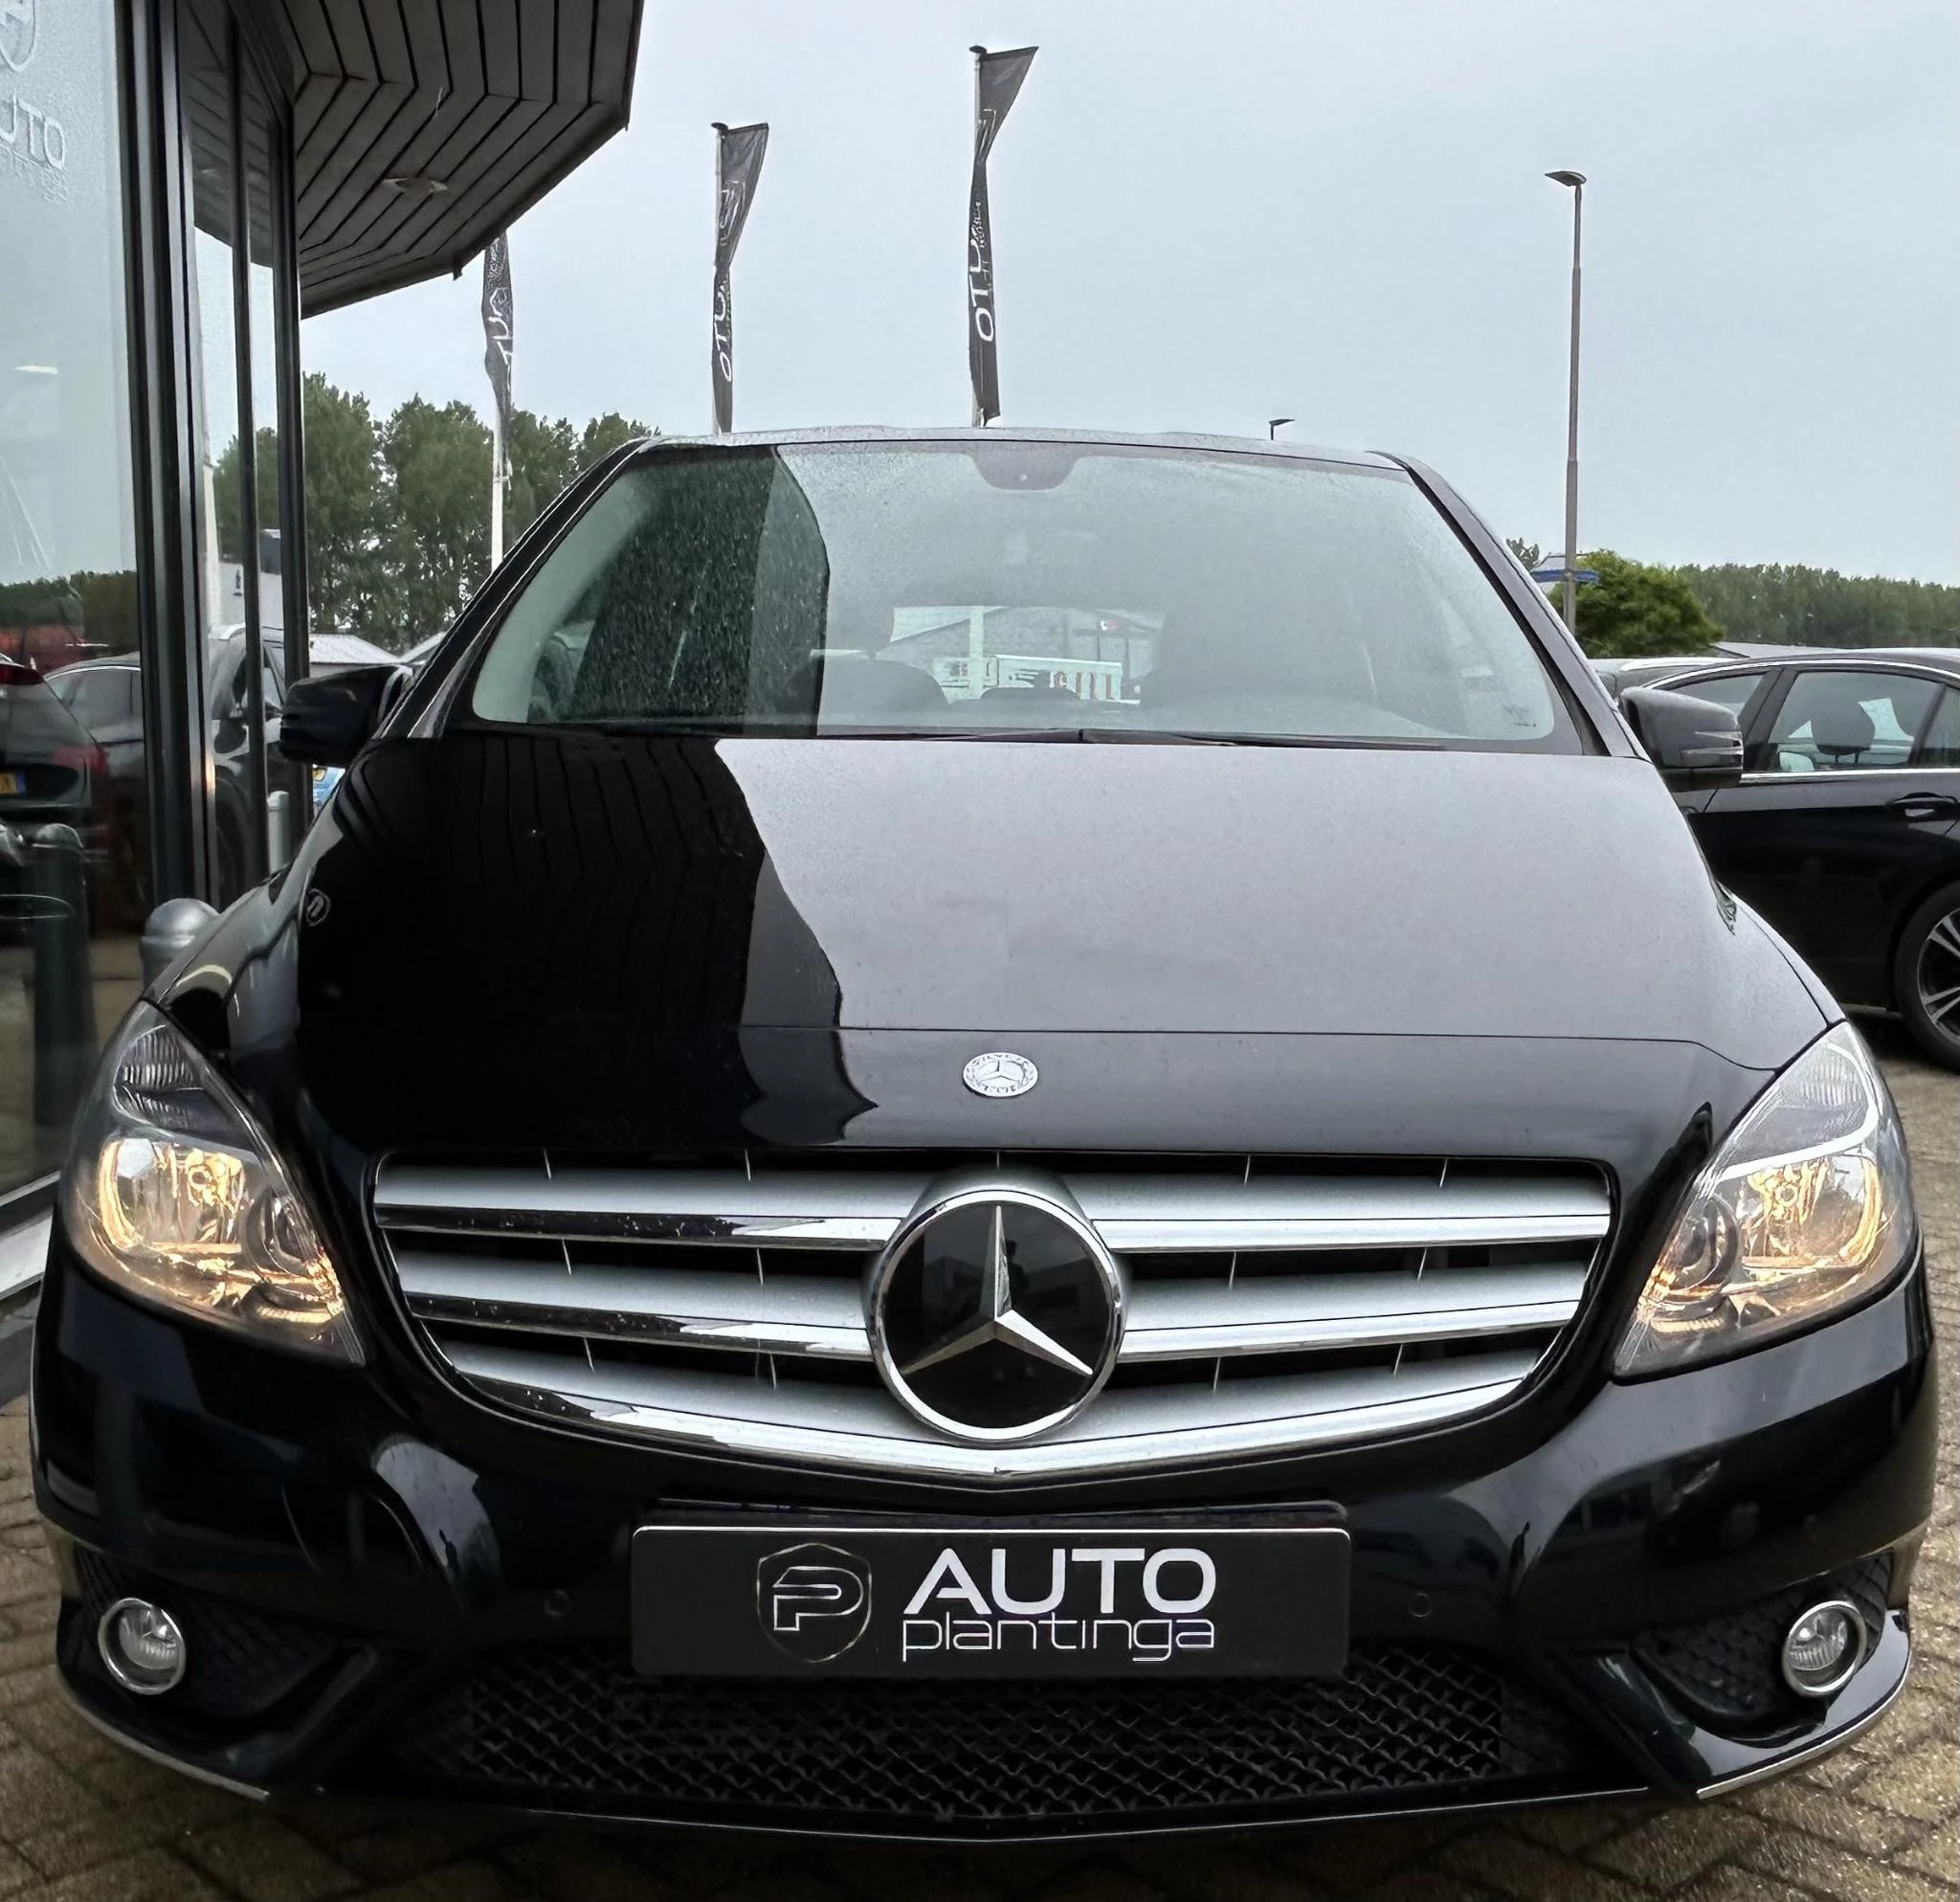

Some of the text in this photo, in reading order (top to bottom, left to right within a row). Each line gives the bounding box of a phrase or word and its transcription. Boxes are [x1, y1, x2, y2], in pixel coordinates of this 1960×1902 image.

[0, 92, 65, 170] UTO
[969, 226, 995, 343] UTO
[713, 283, 733, 383] UTO
[902, 1547, 1216, 1615] AUTO
[902, 1611, 1215, 1662] plantinga
